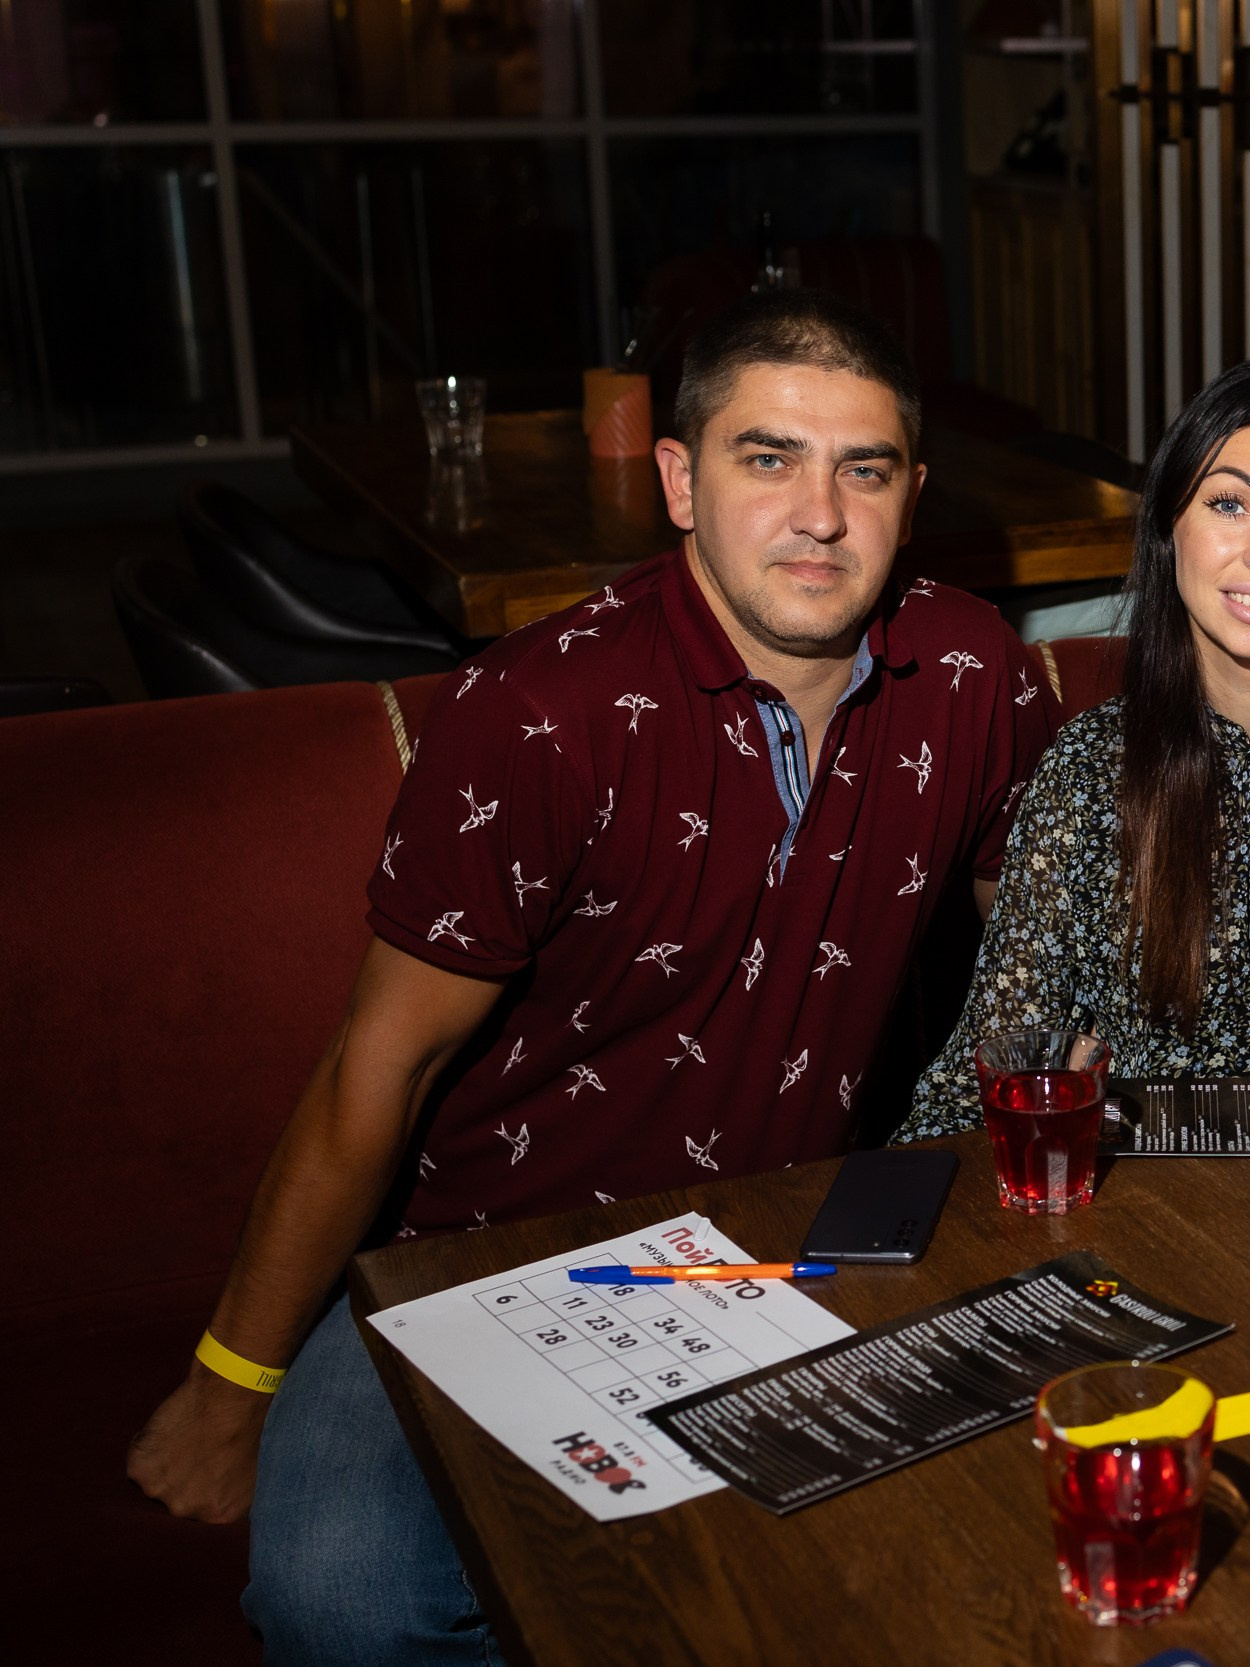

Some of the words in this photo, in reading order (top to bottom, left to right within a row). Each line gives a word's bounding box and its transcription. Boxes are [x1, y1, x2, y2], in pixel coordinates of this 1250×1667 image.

[660, 1227, 766, 1300] ПойТО
[608, 1283, 635, 1297] 18
[496, 1295, 518, 1305] 6
[562, 1297, 588, 1310] 11
[585, 1315, 614, 1331] 23
[653, 1318, 683, 1335] 34
[536, 1329, 567, 1345] 28
[608, 1333, 638, 1349] 30
[682, 1337, 711, 1353] 48
[657, 1371, 688, 1388] 56
[609, 1387, 640, 1405] 52
